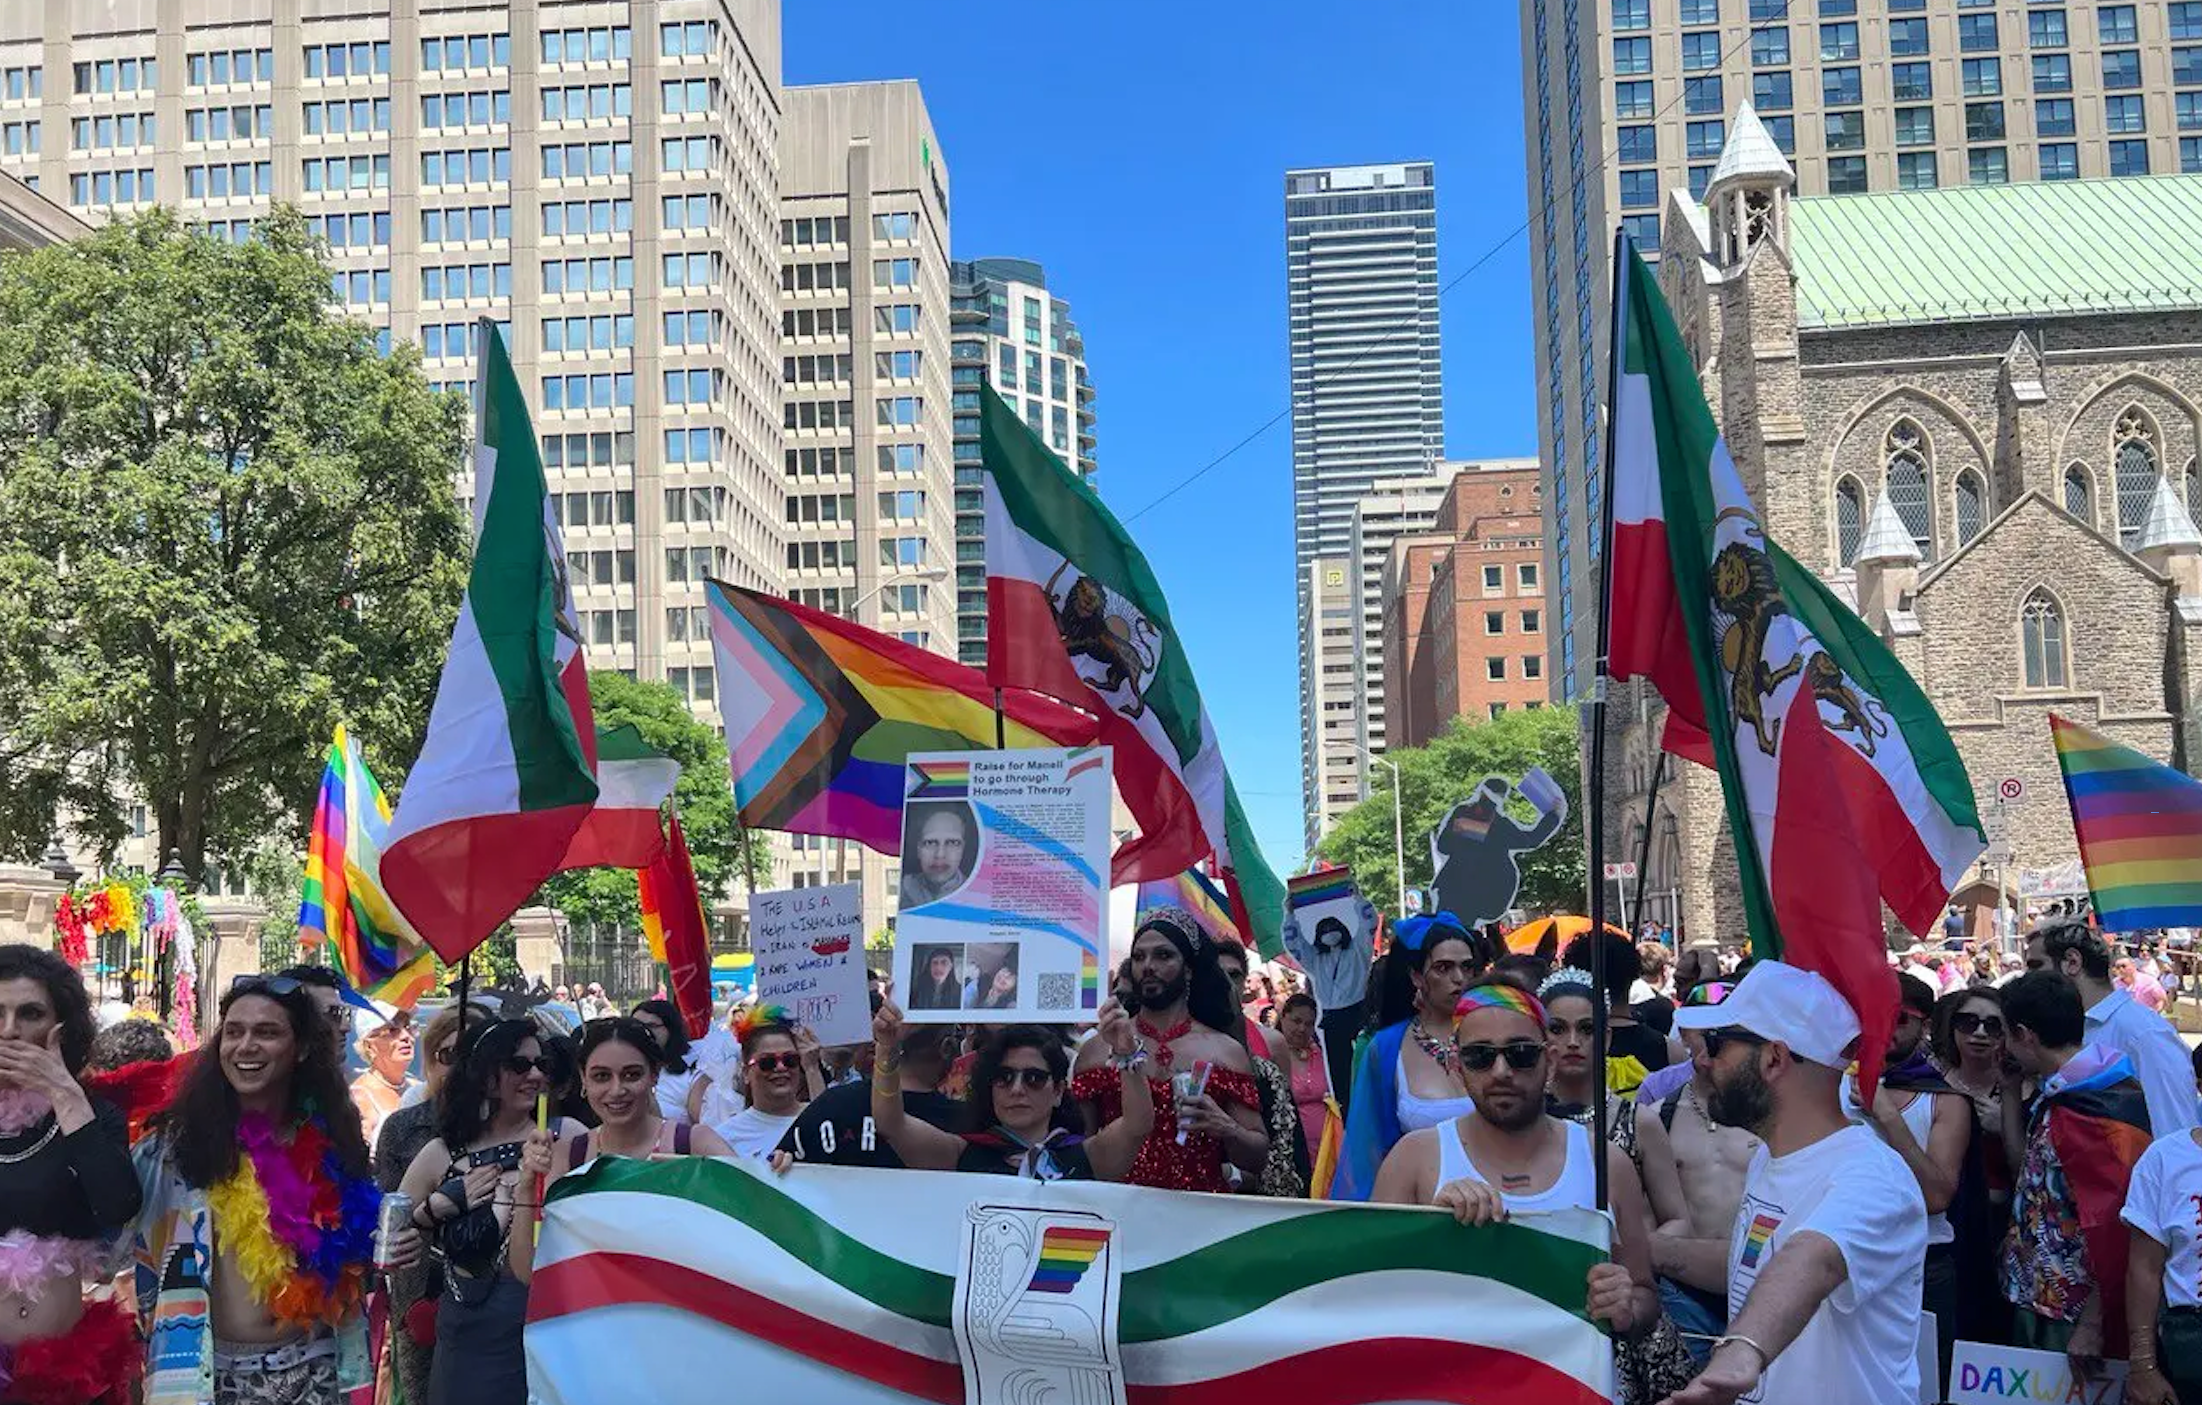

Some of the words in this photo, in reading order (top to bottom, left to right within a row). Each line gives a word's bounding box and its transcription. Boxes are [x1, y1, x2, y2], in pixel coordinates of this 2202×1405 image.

[974, 762, 1005, 771] Raise
[1008, 761, 1025, 770] for
[973, 775, 985, 783] to
[988, 776, 1002, 785] go
[1005, 773, 1049, 784] through
[973, 787, 1024, 796] Hormone
[1027, 785, 1072, 796] Therapy
[761, 900, 783, 917] THE
